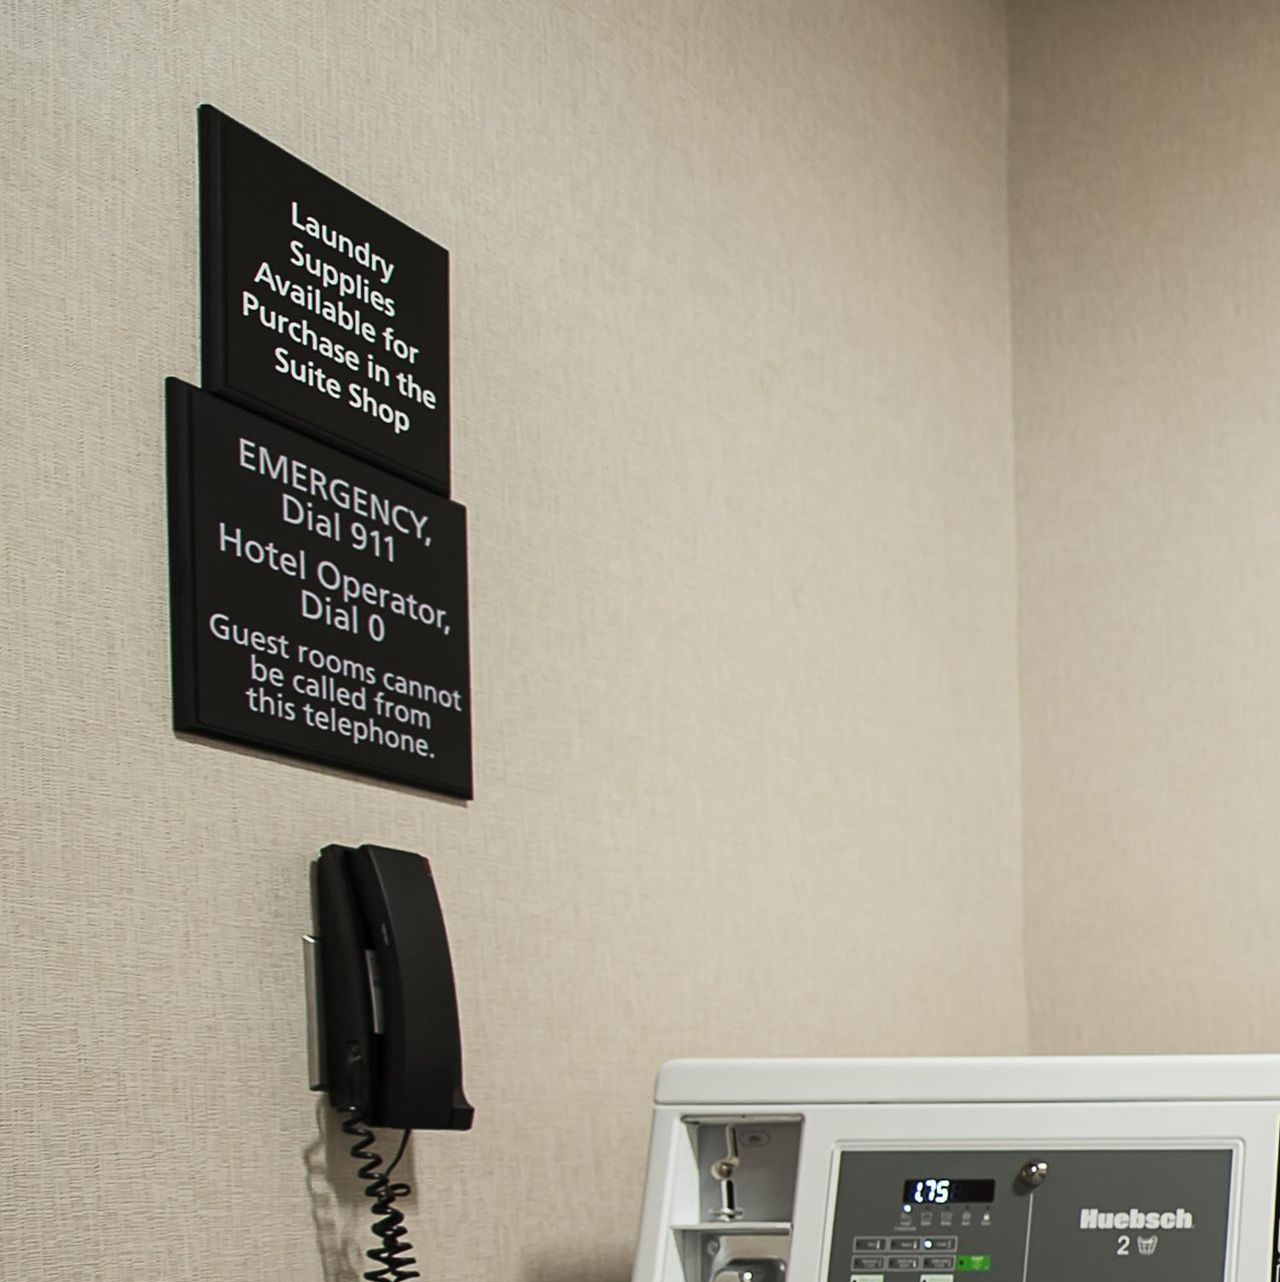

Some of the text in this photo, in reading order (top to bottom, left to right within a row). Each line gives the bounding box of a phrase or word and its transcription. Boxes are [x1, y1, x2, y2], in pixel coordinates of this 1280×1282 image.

[290, 240, 395, 317] Supplies
[292, 201, 394, 284] Laundry
[243, 291, 436, 410] Purchase in the
[254, 262, 419, 364] Available for
[275, 347, 410, 434] Suite Shop
[239, 438, 431, 546] EMERGENCY,
[282, 493, 394, 562] Dial 911
[220, 522, 450, 635] Hotel Operator,
[302, 589, 385, 642] Dial 0
[209, 613, 462, 711] Guest rooms cannot
[251, 654, 431, 729] be called from
[245, 687, 435, 758] this telephone.
[1080, 1208, 1193, 1229] Huebsch
[1116, 1235, 1131, 1256] 2
